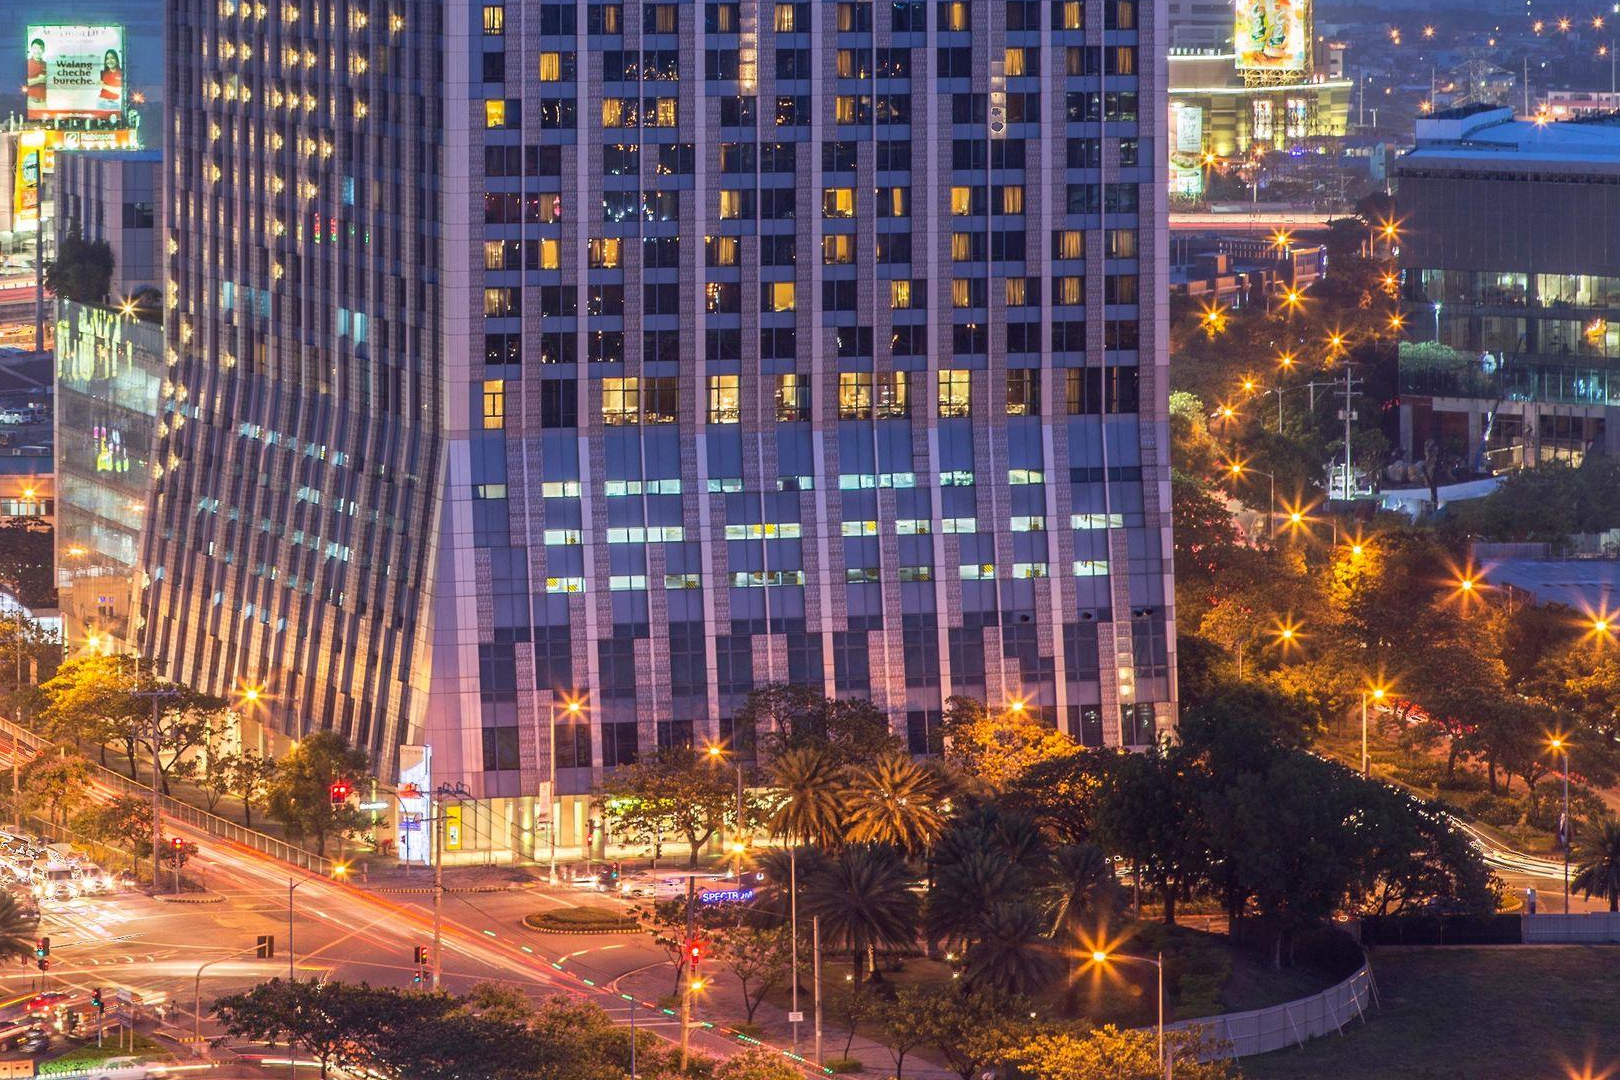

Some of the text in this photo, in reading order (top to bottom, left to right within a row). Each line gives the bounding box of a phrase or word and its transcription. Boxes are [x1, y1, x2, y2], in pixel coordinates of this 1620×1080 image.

[56, 60, 93, 70] Walang
[57, 69, 91, 77] cheche
[53, 77, 95, 85] bureche.
